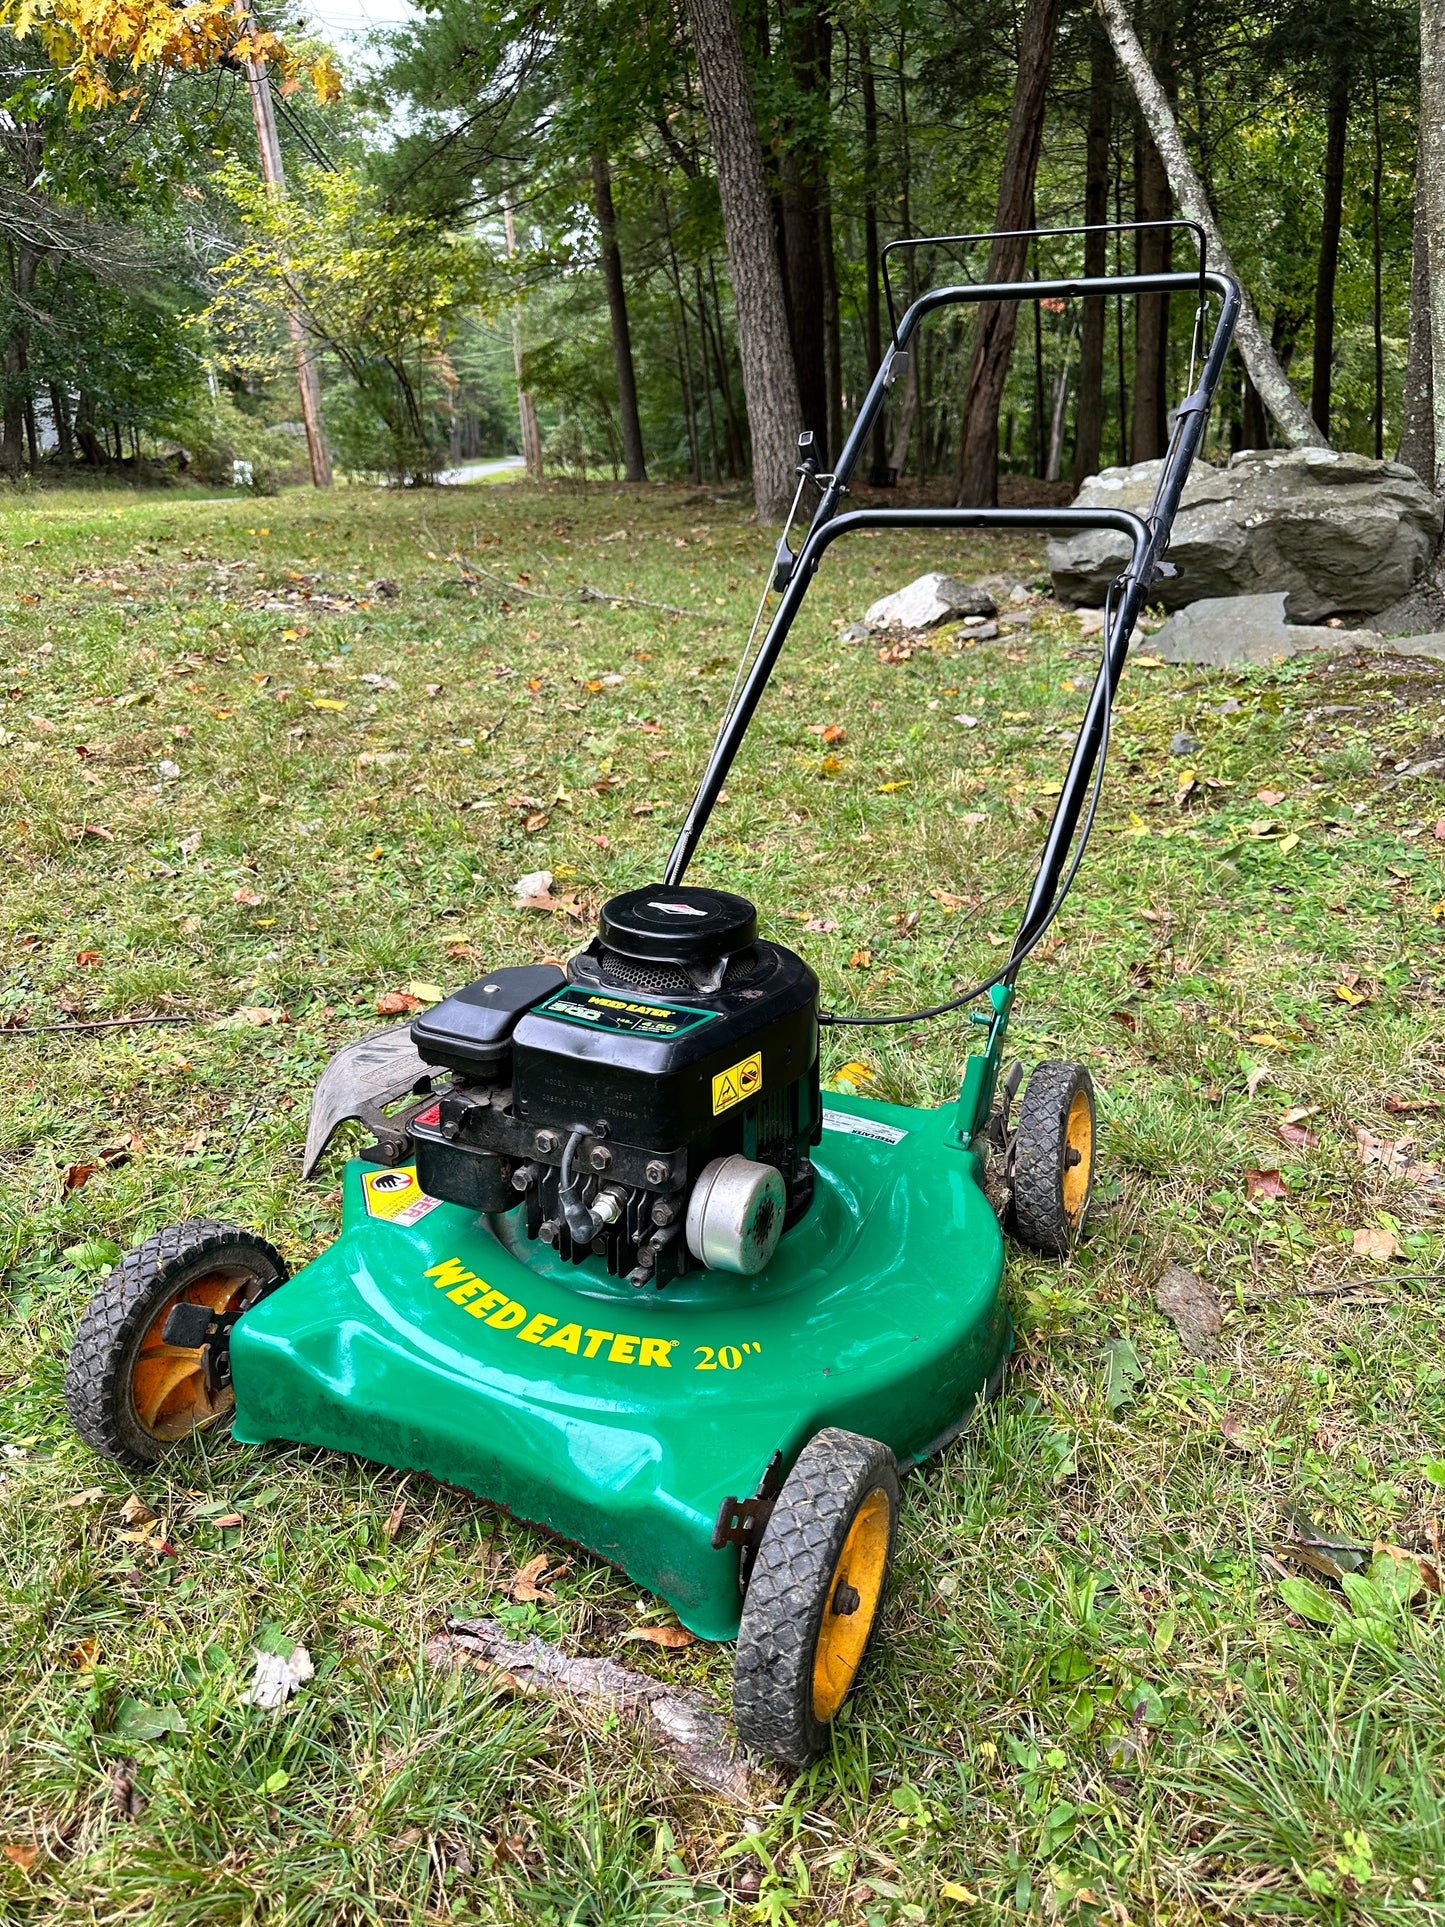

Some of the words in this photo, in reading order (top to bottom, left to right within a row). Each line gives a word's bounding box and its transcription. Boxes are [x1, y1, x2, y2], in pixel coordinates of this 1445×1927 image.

[588, 996, 627, 1010] WEED
[625, 1004, 672, 1018] EATER
[544, 1077, 566, 1088] MODEL
[615, 1091, 633, 1102] CODE
[423, 1256, 528, 1330] WEED
[693, 1341, 762, 1371] 20"
